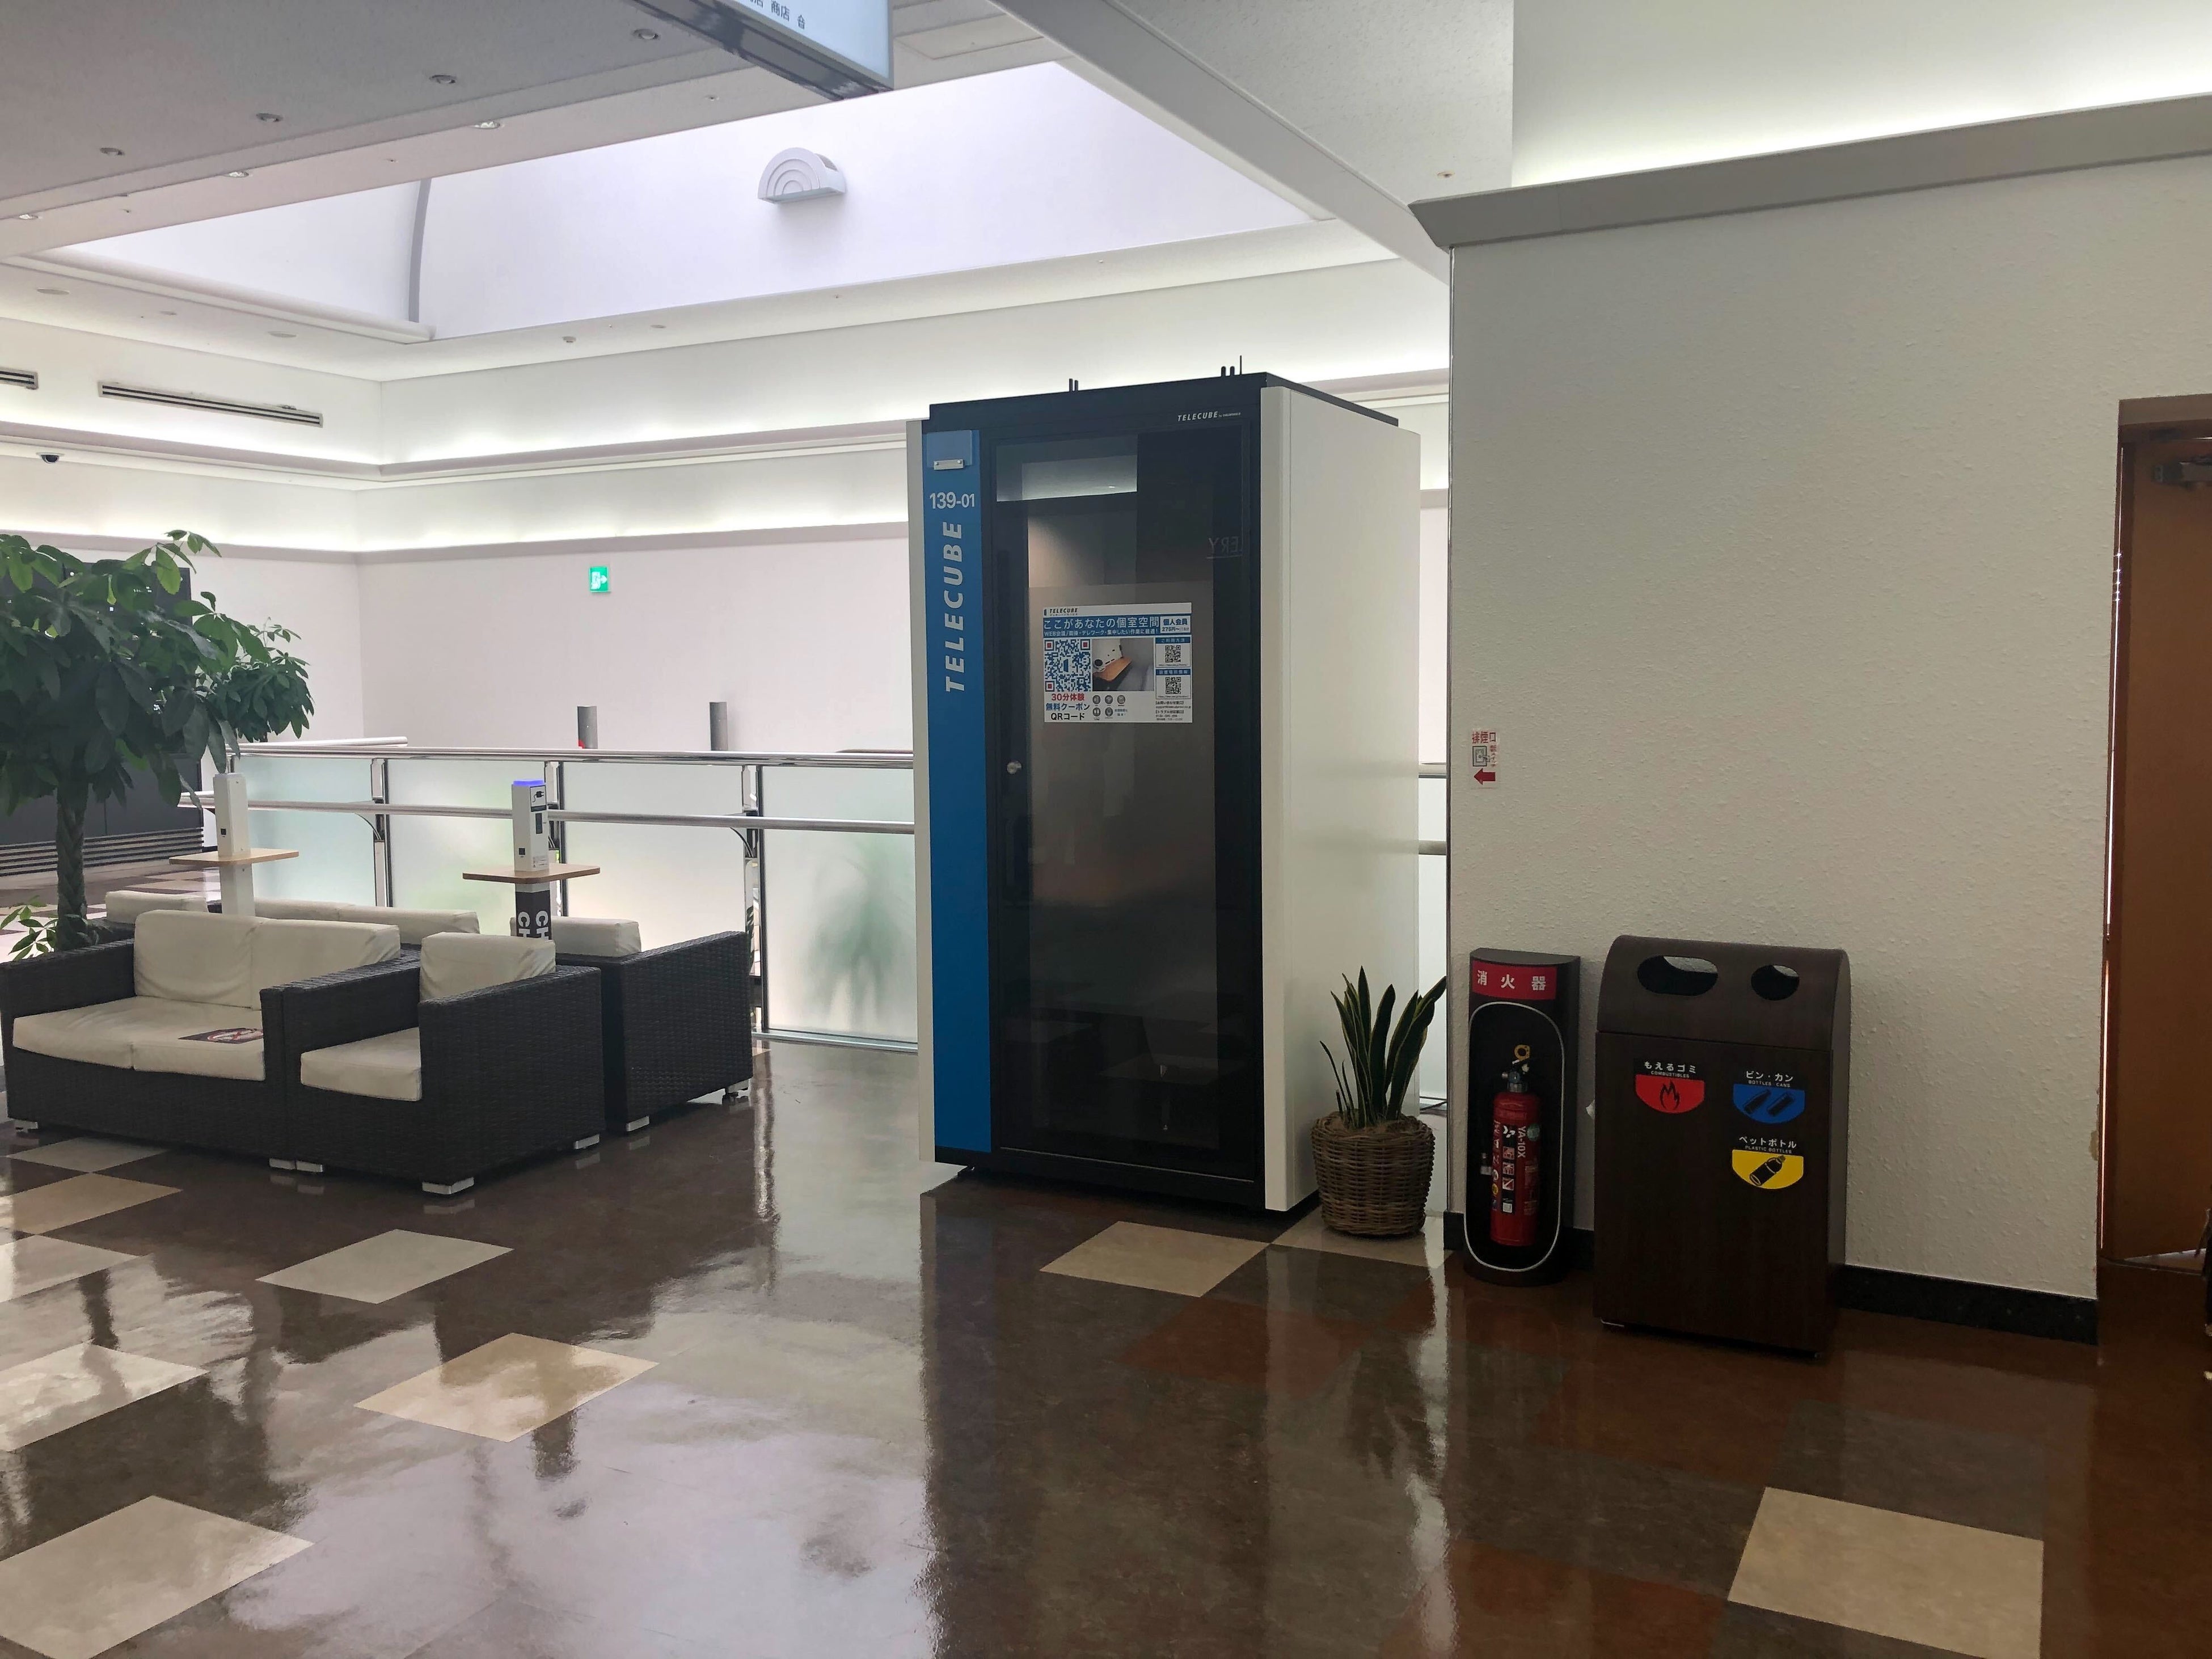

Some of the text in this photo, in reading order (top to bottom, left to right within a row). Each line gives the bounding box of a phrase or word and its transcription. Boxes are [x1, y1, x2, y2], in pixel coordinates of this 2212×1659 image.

[1178, 411, 1218, 421] TELECUBE
[930, 492, 975, 509] 139-01
[943, 521, 965, 692] TELECUBE
[1044, 616, 1159, 630] ここがあなたの個室空間
[1046, 703, 1090, 711] 無料クーポン
[1051, 712, 1085, 721] QRコード
[1478, 969, 1547, 991] 消火器
[1644, 1061, 1696, 1074] もえるゴミ
[1517, 1125, 1527, 1158] YA-10X
[1739, 1135, 1797, 1149] ペットボトル
